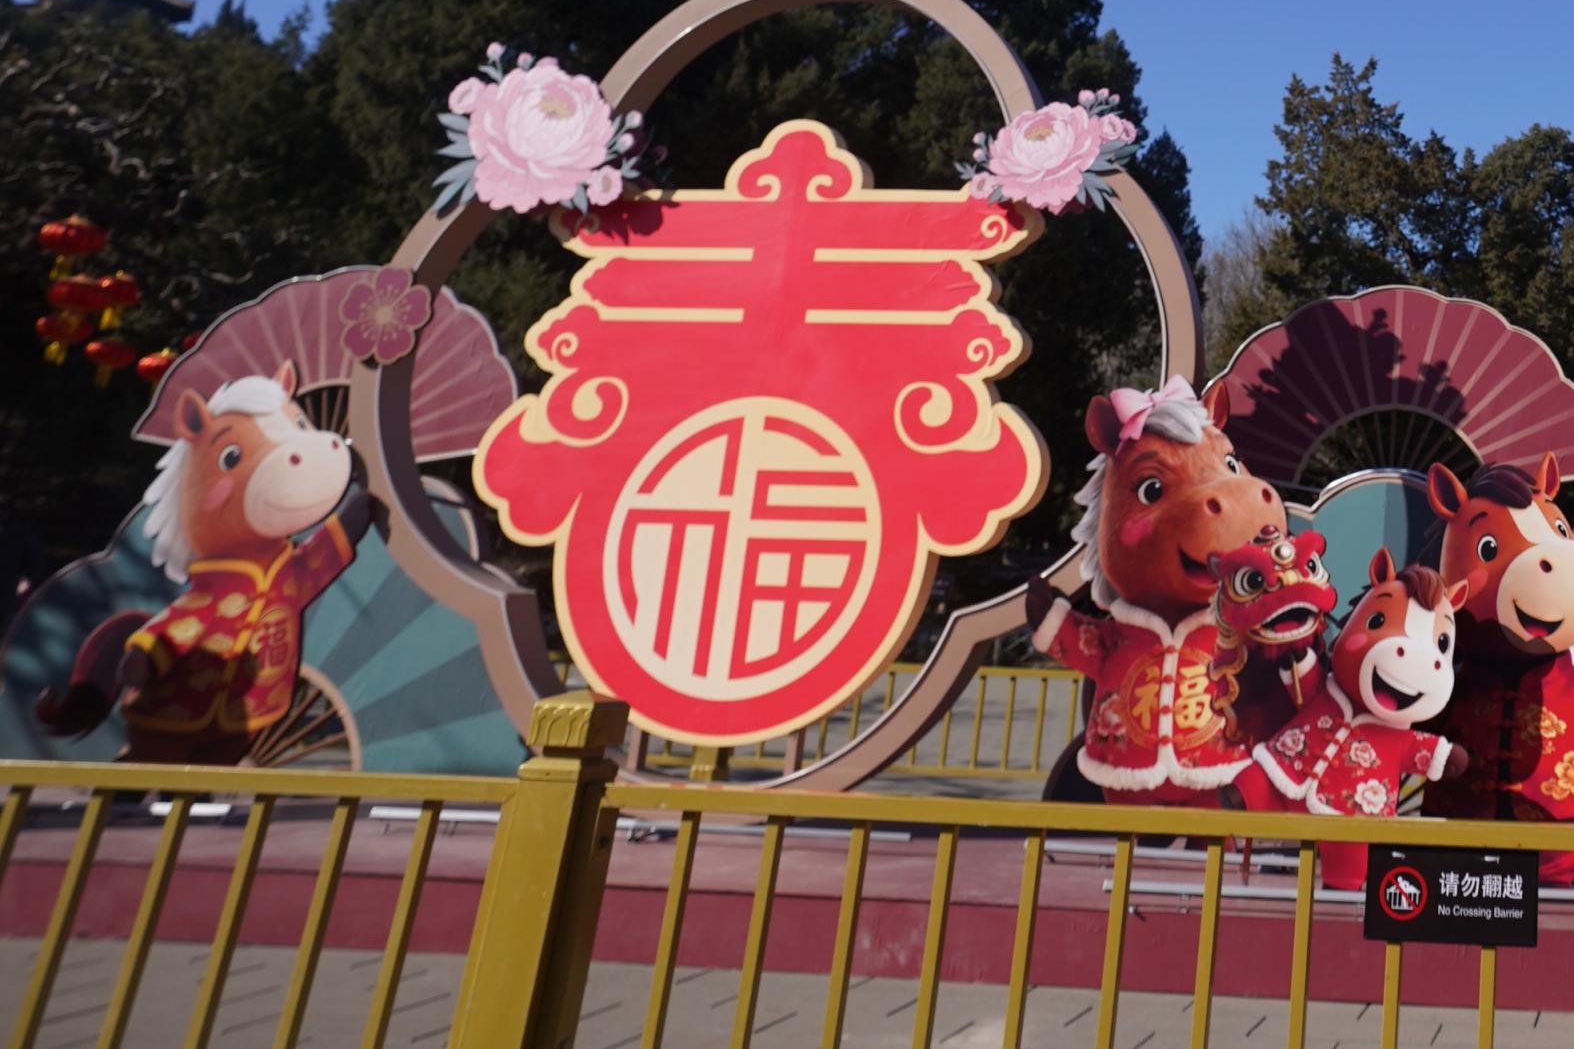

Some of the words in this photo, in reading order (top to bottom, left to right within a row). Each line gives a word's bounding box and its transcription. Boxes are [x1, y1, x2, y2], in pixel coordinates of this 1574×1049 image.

[610, 408, 874, 690] 福
[1132, 663, 1213, 730] 福
[1438, 870, 1524, 900] 请勿翻越
[1437, 904, 1451, 916] No
[1453, 906, 1491, 920] Crossing
[1494, 909, 1524, 919] Barrier
